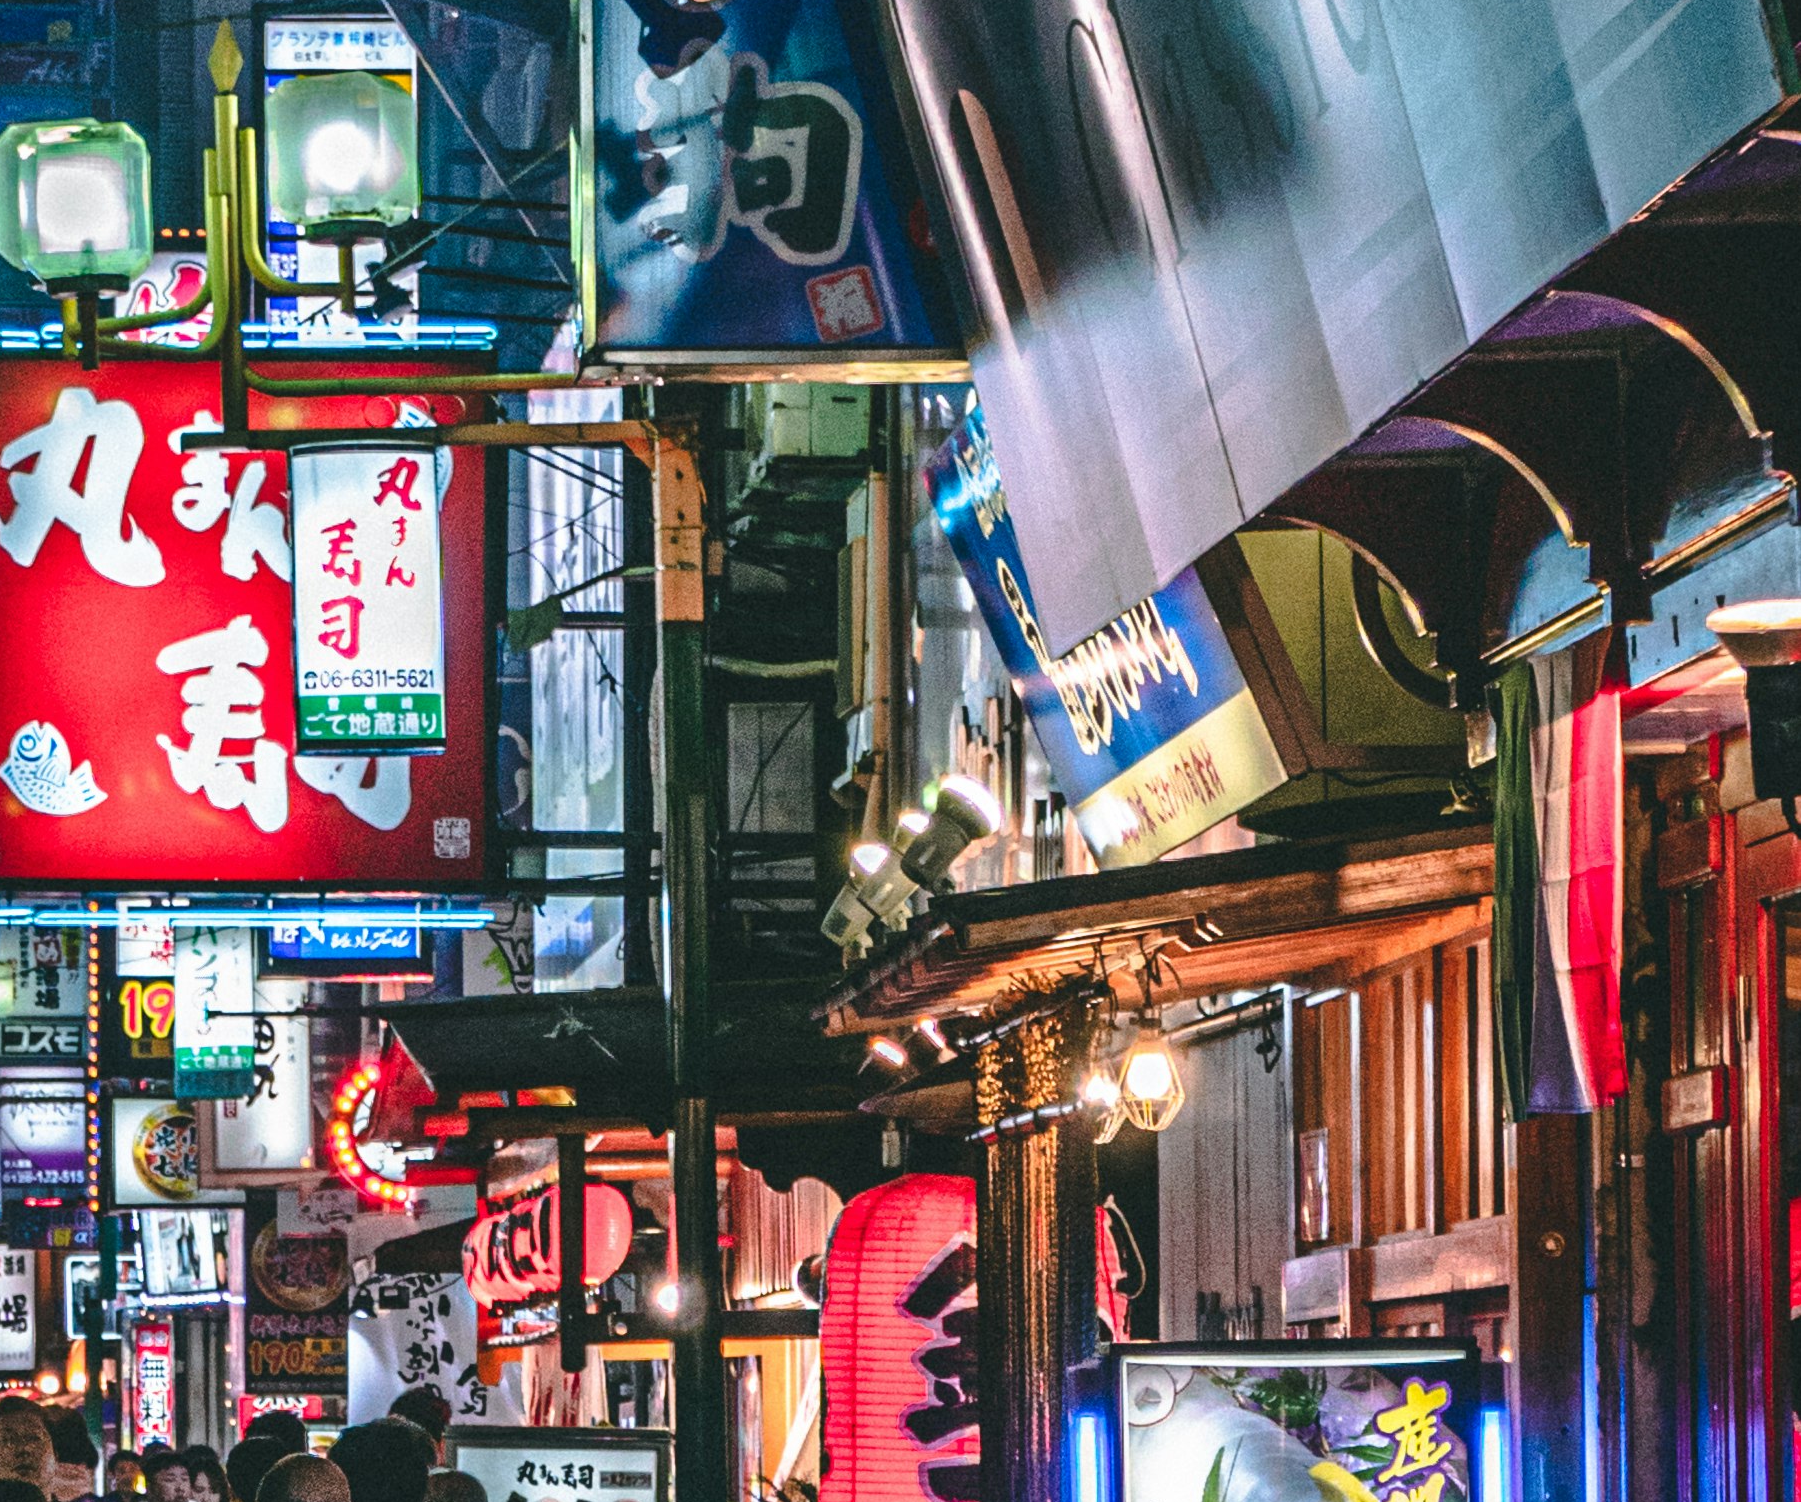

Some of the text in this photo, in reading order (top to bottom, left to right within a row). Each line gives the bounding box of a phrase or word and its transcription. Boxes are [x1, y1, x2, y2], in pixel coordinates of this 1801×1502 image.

[373, 456, 424, 589] 丸まん
[318, 518, 364, 660] 寿司
[320, 668, 435, 689] 06-6311-5621
[304, 712, 438, 737] ごて地蔵通り
[4, 1025, 80, 1053] コスモ
